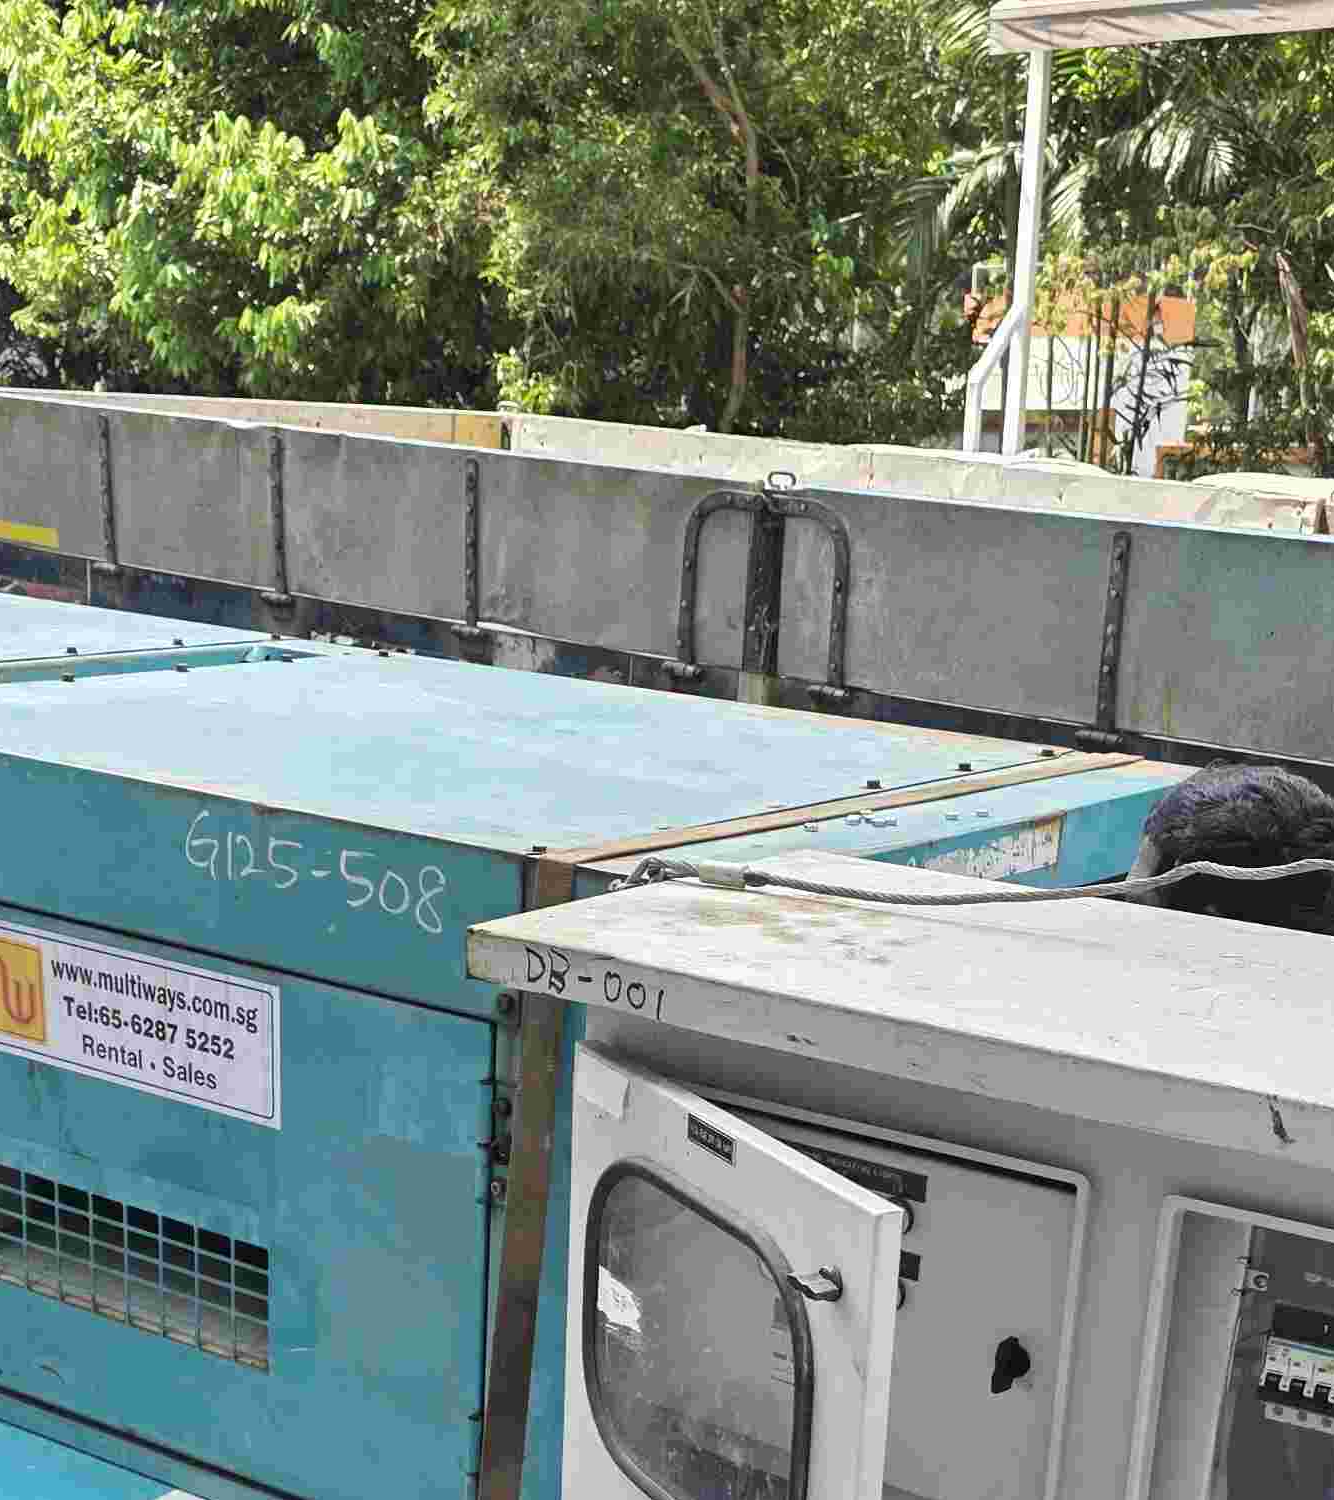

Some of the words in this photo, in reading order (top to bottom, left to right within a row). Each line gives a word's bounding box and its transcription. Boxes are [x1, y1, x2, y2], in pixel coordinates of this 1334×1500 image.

[51, 959, 259, 1034] www.multiways.com.sg
[525, 943, 665, 1021] DB-001
[82, 1034, 144, 1070] Rental
[163, 1056, 218, 1090] Sales
[185, 1028, 236, 1060] 5252
